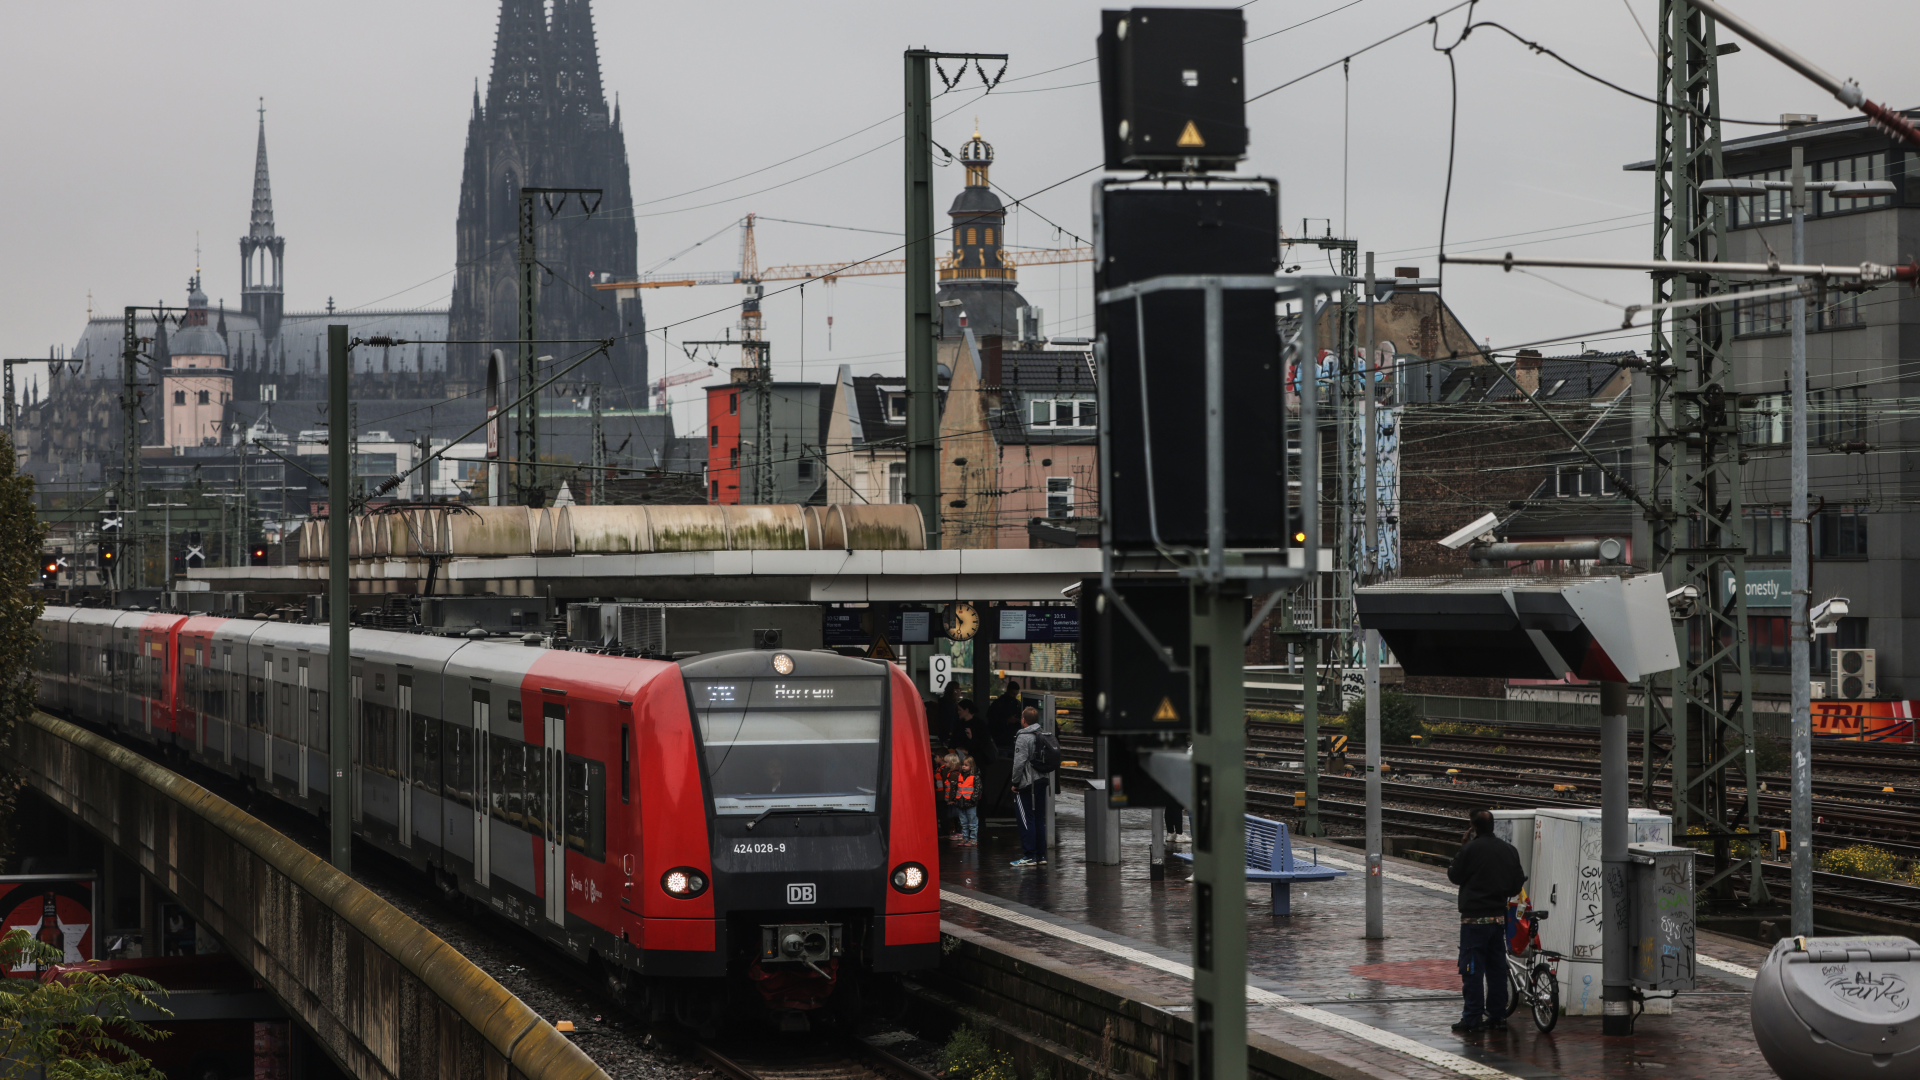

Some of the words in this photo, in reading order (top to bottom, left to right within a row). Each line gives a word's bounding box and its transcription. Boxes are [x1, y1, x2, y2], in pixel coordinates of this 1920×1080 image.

[1817, 704, 1864, 728] TRI
[733, 844, 753, 854] 424
[754, 843, 786, 853] 028-9
[790, 886, 814, 900] DB
